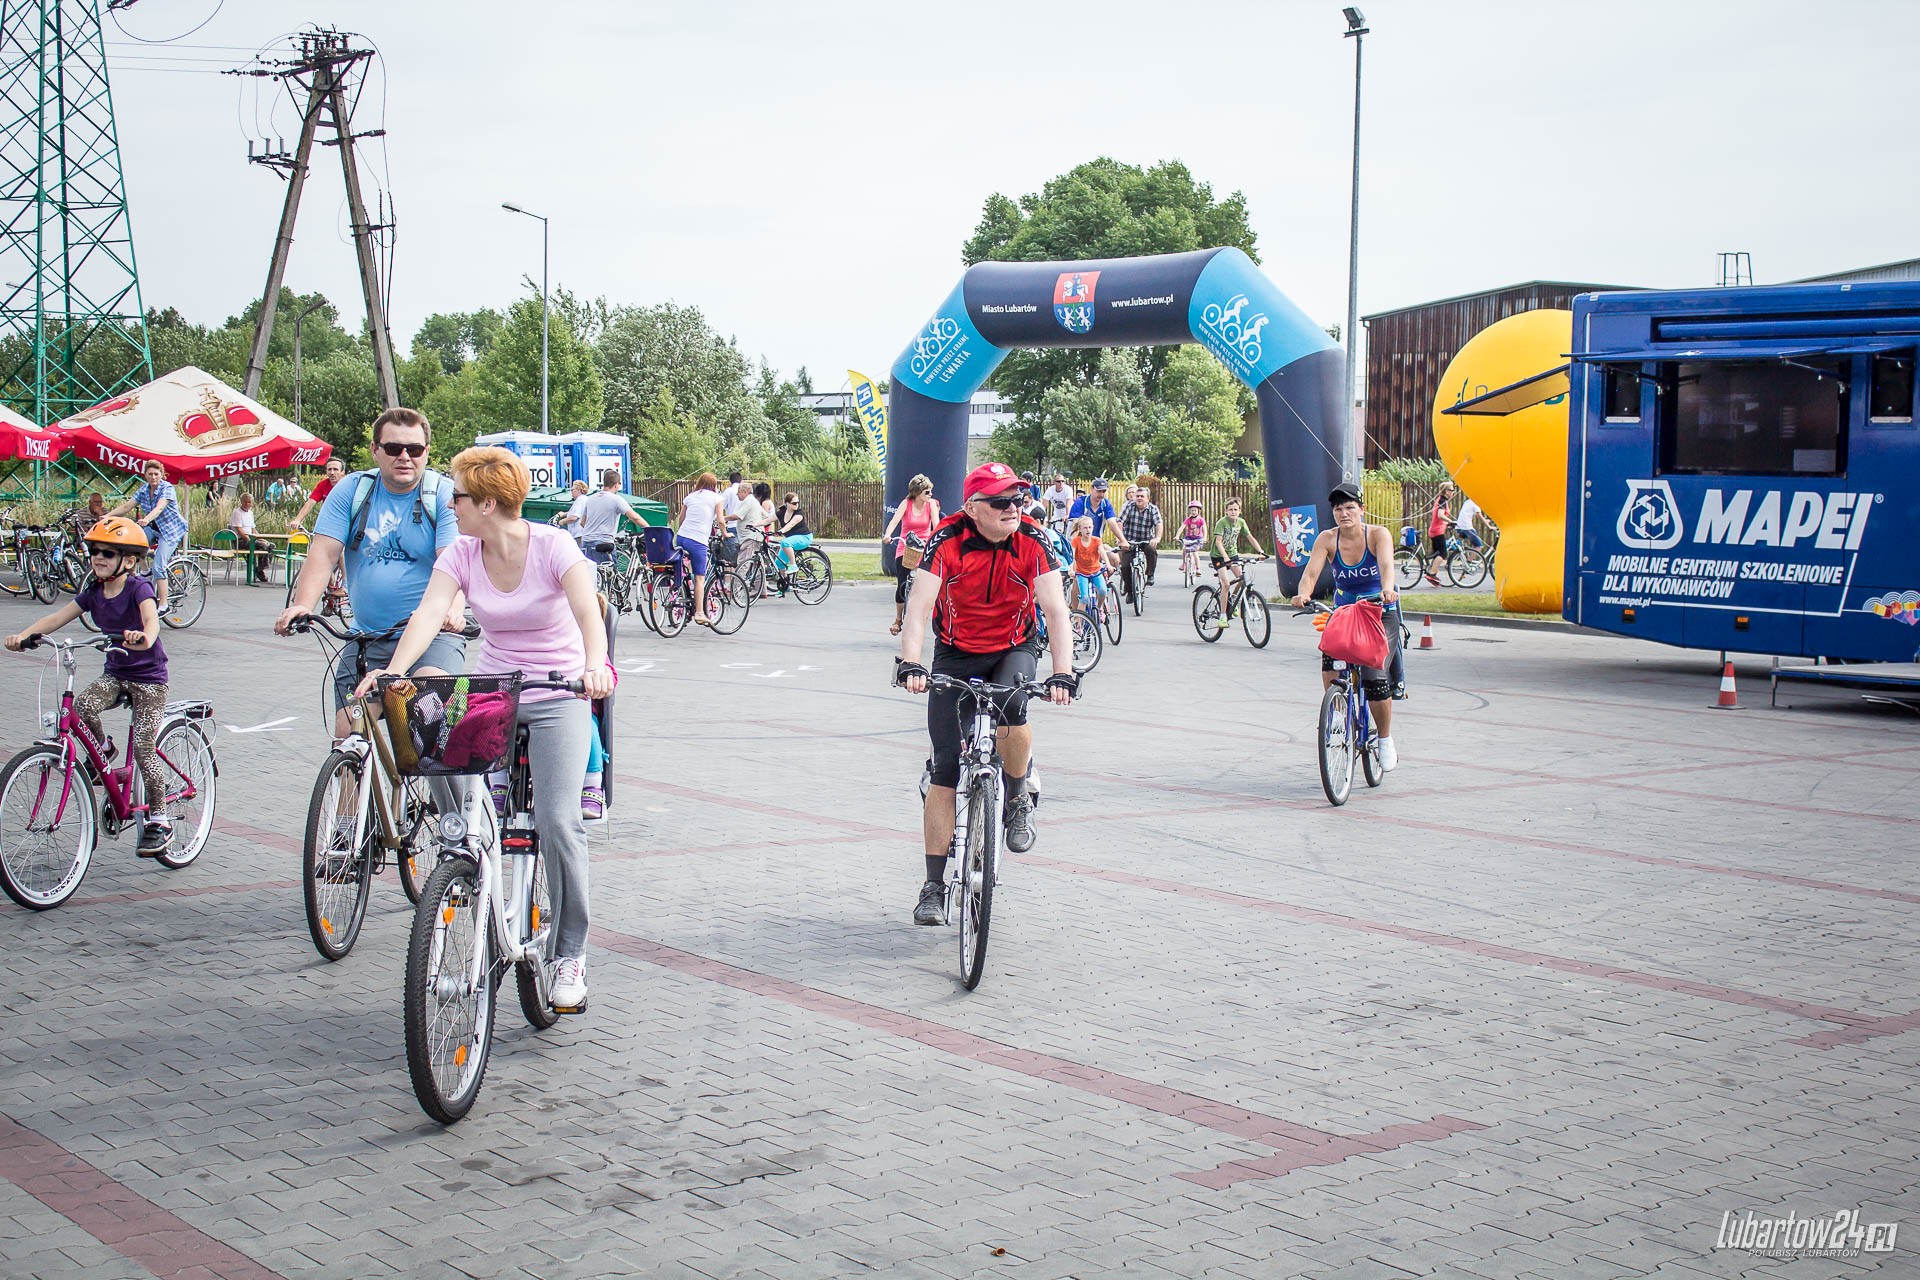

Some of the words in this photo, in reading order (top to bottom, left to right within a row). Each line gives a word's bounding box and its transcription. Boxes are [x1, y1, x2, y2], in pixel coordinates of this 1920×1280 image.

[982, 305, 1004, 313] Miasto
[1005, 304, 1037, 313] Lubartów
[1111, 294, 1174, 308] www.lubartow.pl
[939, 350, 972, 383] LEWARTA
[25, 436, 51, 458] TYSKIE
[291, 447, 323, 462] TYSKIE
[96, 443, 147, 474] TYSKI
[205, 452, 269, 478] TYSKIE
[1693, 489, 1874, 550] MAPEI
[1332, 566, 1378, 579] DANCE
[1607, 555, 1669, 575] MOBILNE
[1670, 558, 1739, 578] CENTRUM
[1740, 561, 1844, 583] SZKOLENIOWE
[1602, 575, 1629, 592] DLA
[1631, 577, 1734, 598] WYKONAWCÓW
[1599, 596, 1651, 608] www.mapei.pl
